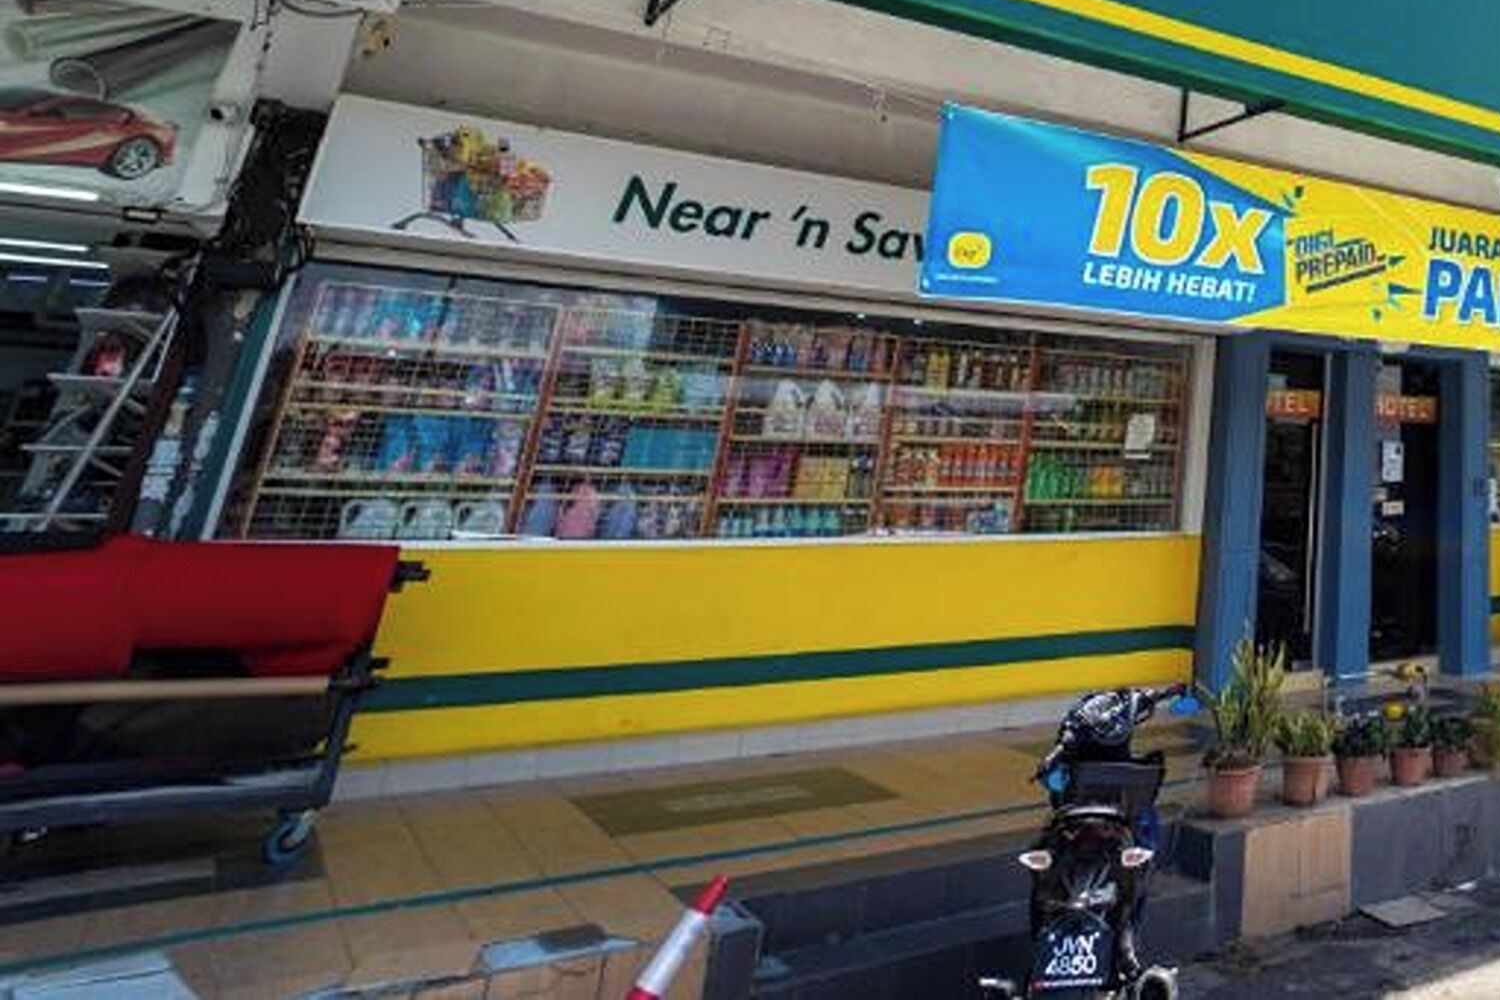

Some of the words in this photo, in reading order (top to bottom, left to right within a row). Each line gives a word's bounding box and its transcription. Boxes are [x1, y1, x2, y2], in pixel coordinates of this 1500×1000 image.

[612, 173, 772, 240] Near
[1085, 162, 1274, 275] 10x
[1082, 261, 1163, 293] LEBIH
[1165, 271, 1257, 304] HEBAT!
